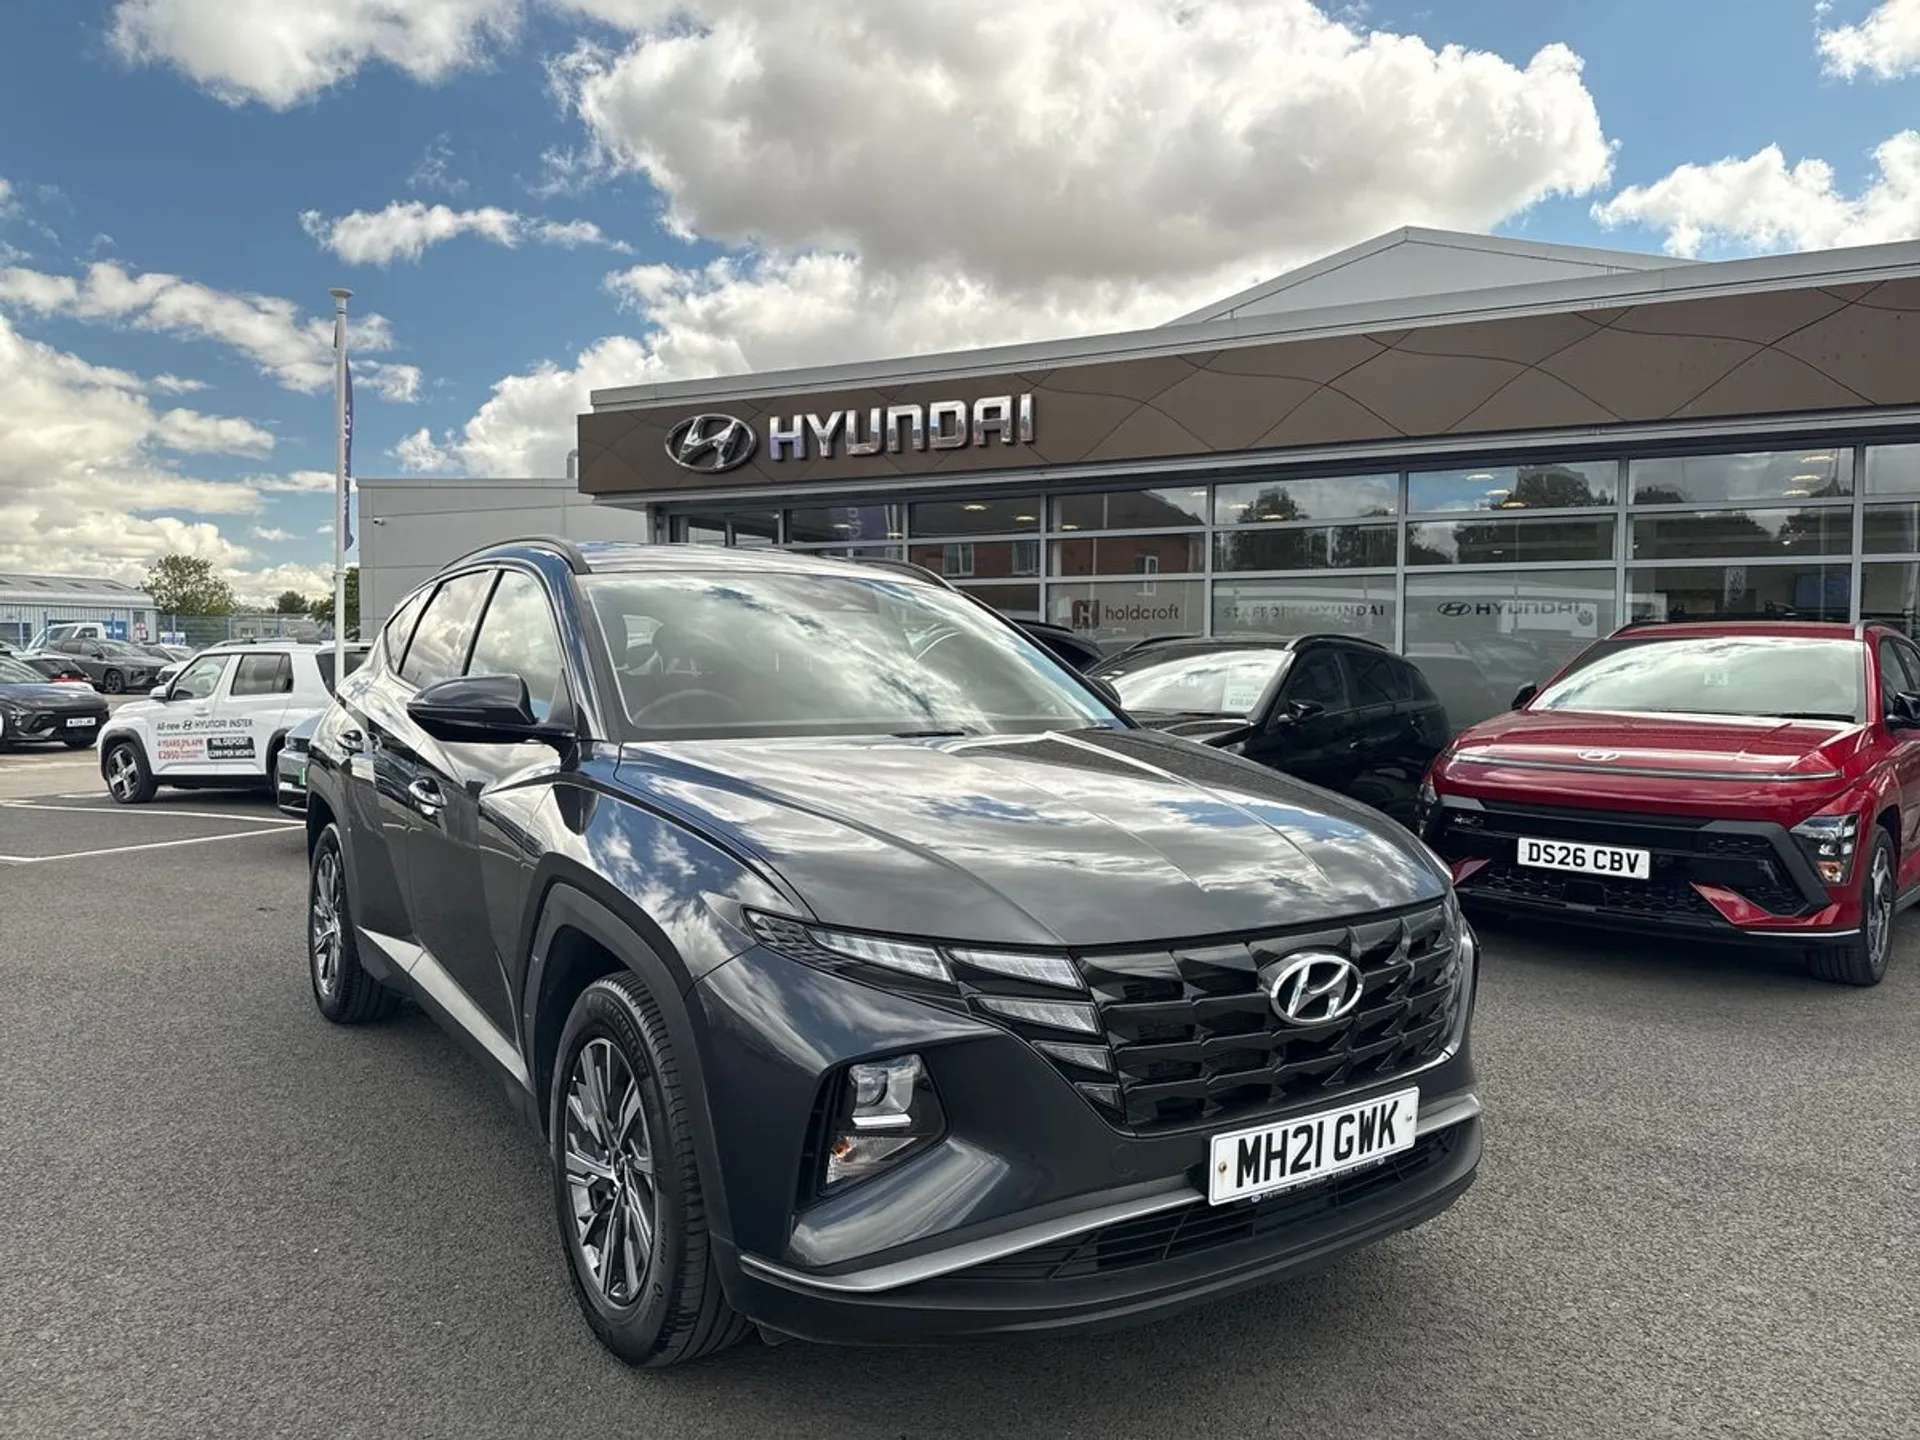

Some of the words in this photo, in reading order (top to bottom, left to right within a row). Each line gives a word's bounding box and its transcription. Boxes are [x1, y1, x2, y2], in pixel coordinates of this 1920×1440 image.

[768, 393, 1034, 461] HYUNDAI
[1104, 604, 1179, 620] holdcroft
[1223, 604, 1302, 618] STFFO
[1475, 602, 1580, 616] HYUNDAI
[1527, 842, 1586, 868] DS26
[1593, 849, 1640, 874] CBV
[1236, 1120, 1325, 1189] MH21
[1333, 1100, 1399, 1162] GWK
